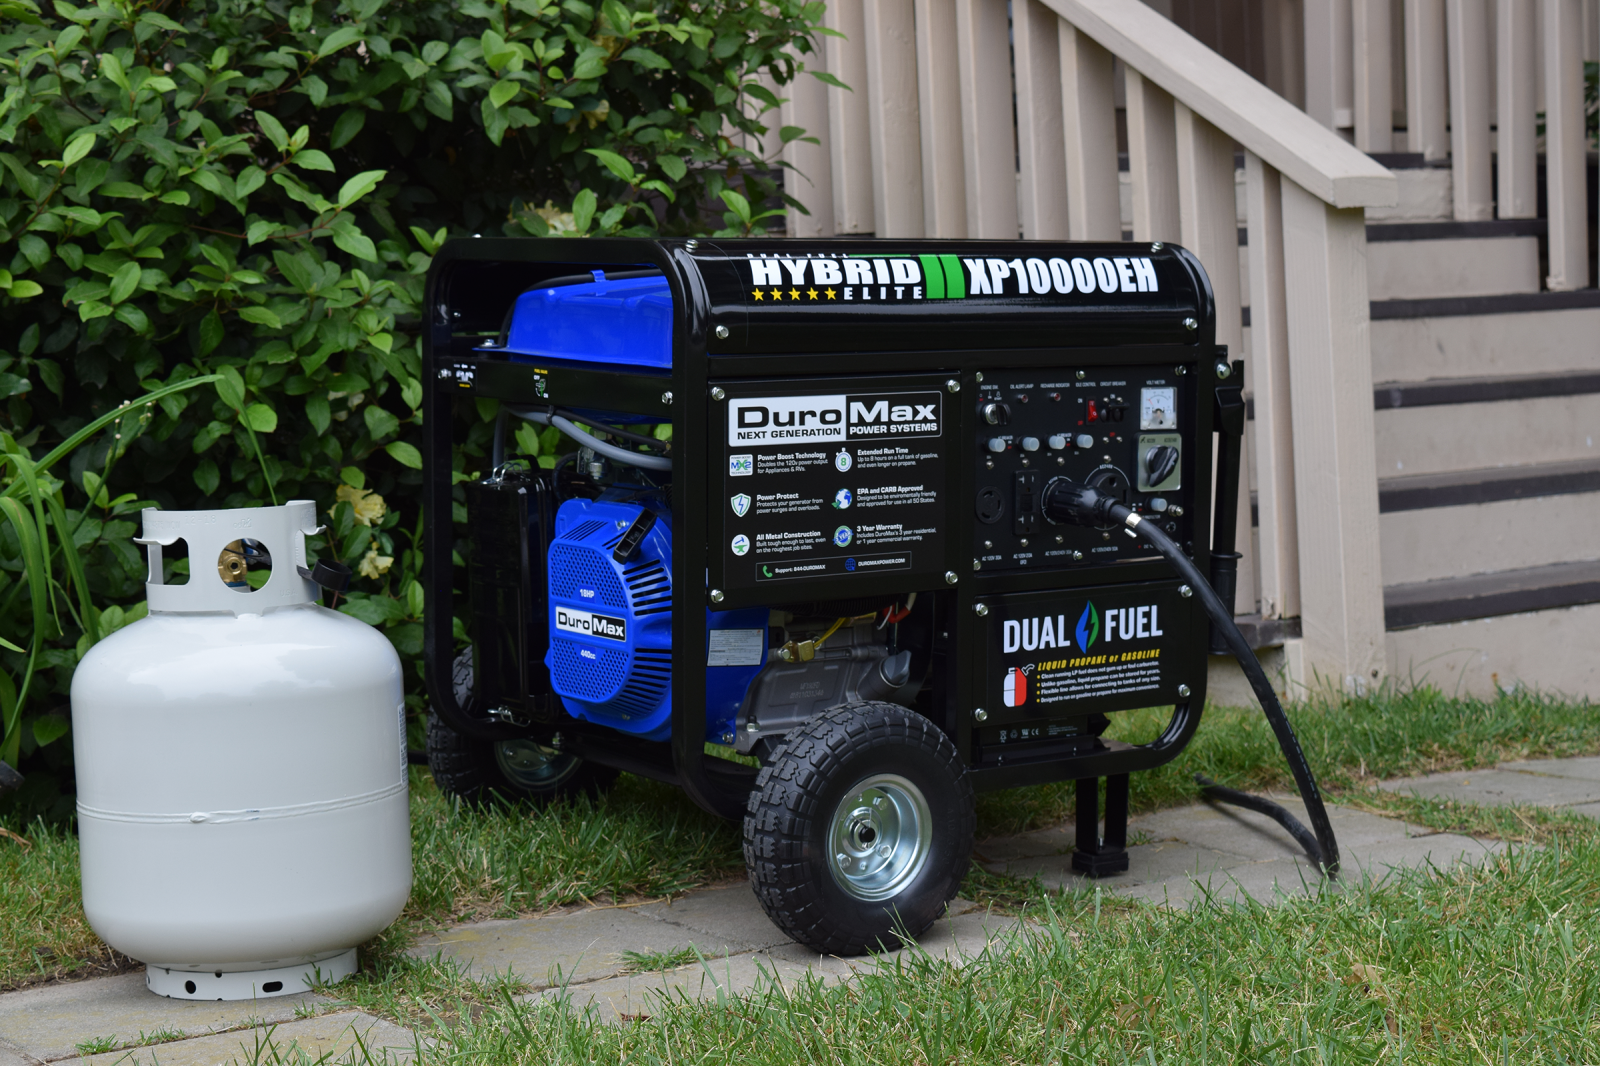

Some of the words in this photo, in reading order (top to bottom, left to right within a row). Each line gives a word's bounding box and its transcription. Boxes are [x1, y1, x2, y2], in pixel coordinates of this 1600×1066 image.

[750, 259, 922, 286] HYBRID
[963, 258, 1158, 294] XP10000EH
[844, 286, 922, 300] ELITE
[737, 401, 936, 429] DuroMax
[737, 431, 767, 440] NEXT
[771, 428, 841, 438] GENERATION
[850, 425, 887, 435] POWER
[890, 423, 937, 433] SYSTEMS
[731, 459, 752, 471] MX2
[841, 458, 847, 466] 8
[580, 589, 595, 598] 18HP
[558, 612, 624, 636] DuroMax
[1004, 614, 1070, 653] DUAL
[1105, 605, 1163, 642] FUEL
[580, 650, 596, 659] 440cc
[1038, 660, 1066, 671] LIQUID
[1069, 655, 1106, 668] PROPANE
[1109, 655, 1119, 663] or
[1121, 649, 1160, 661] GASOLINE
